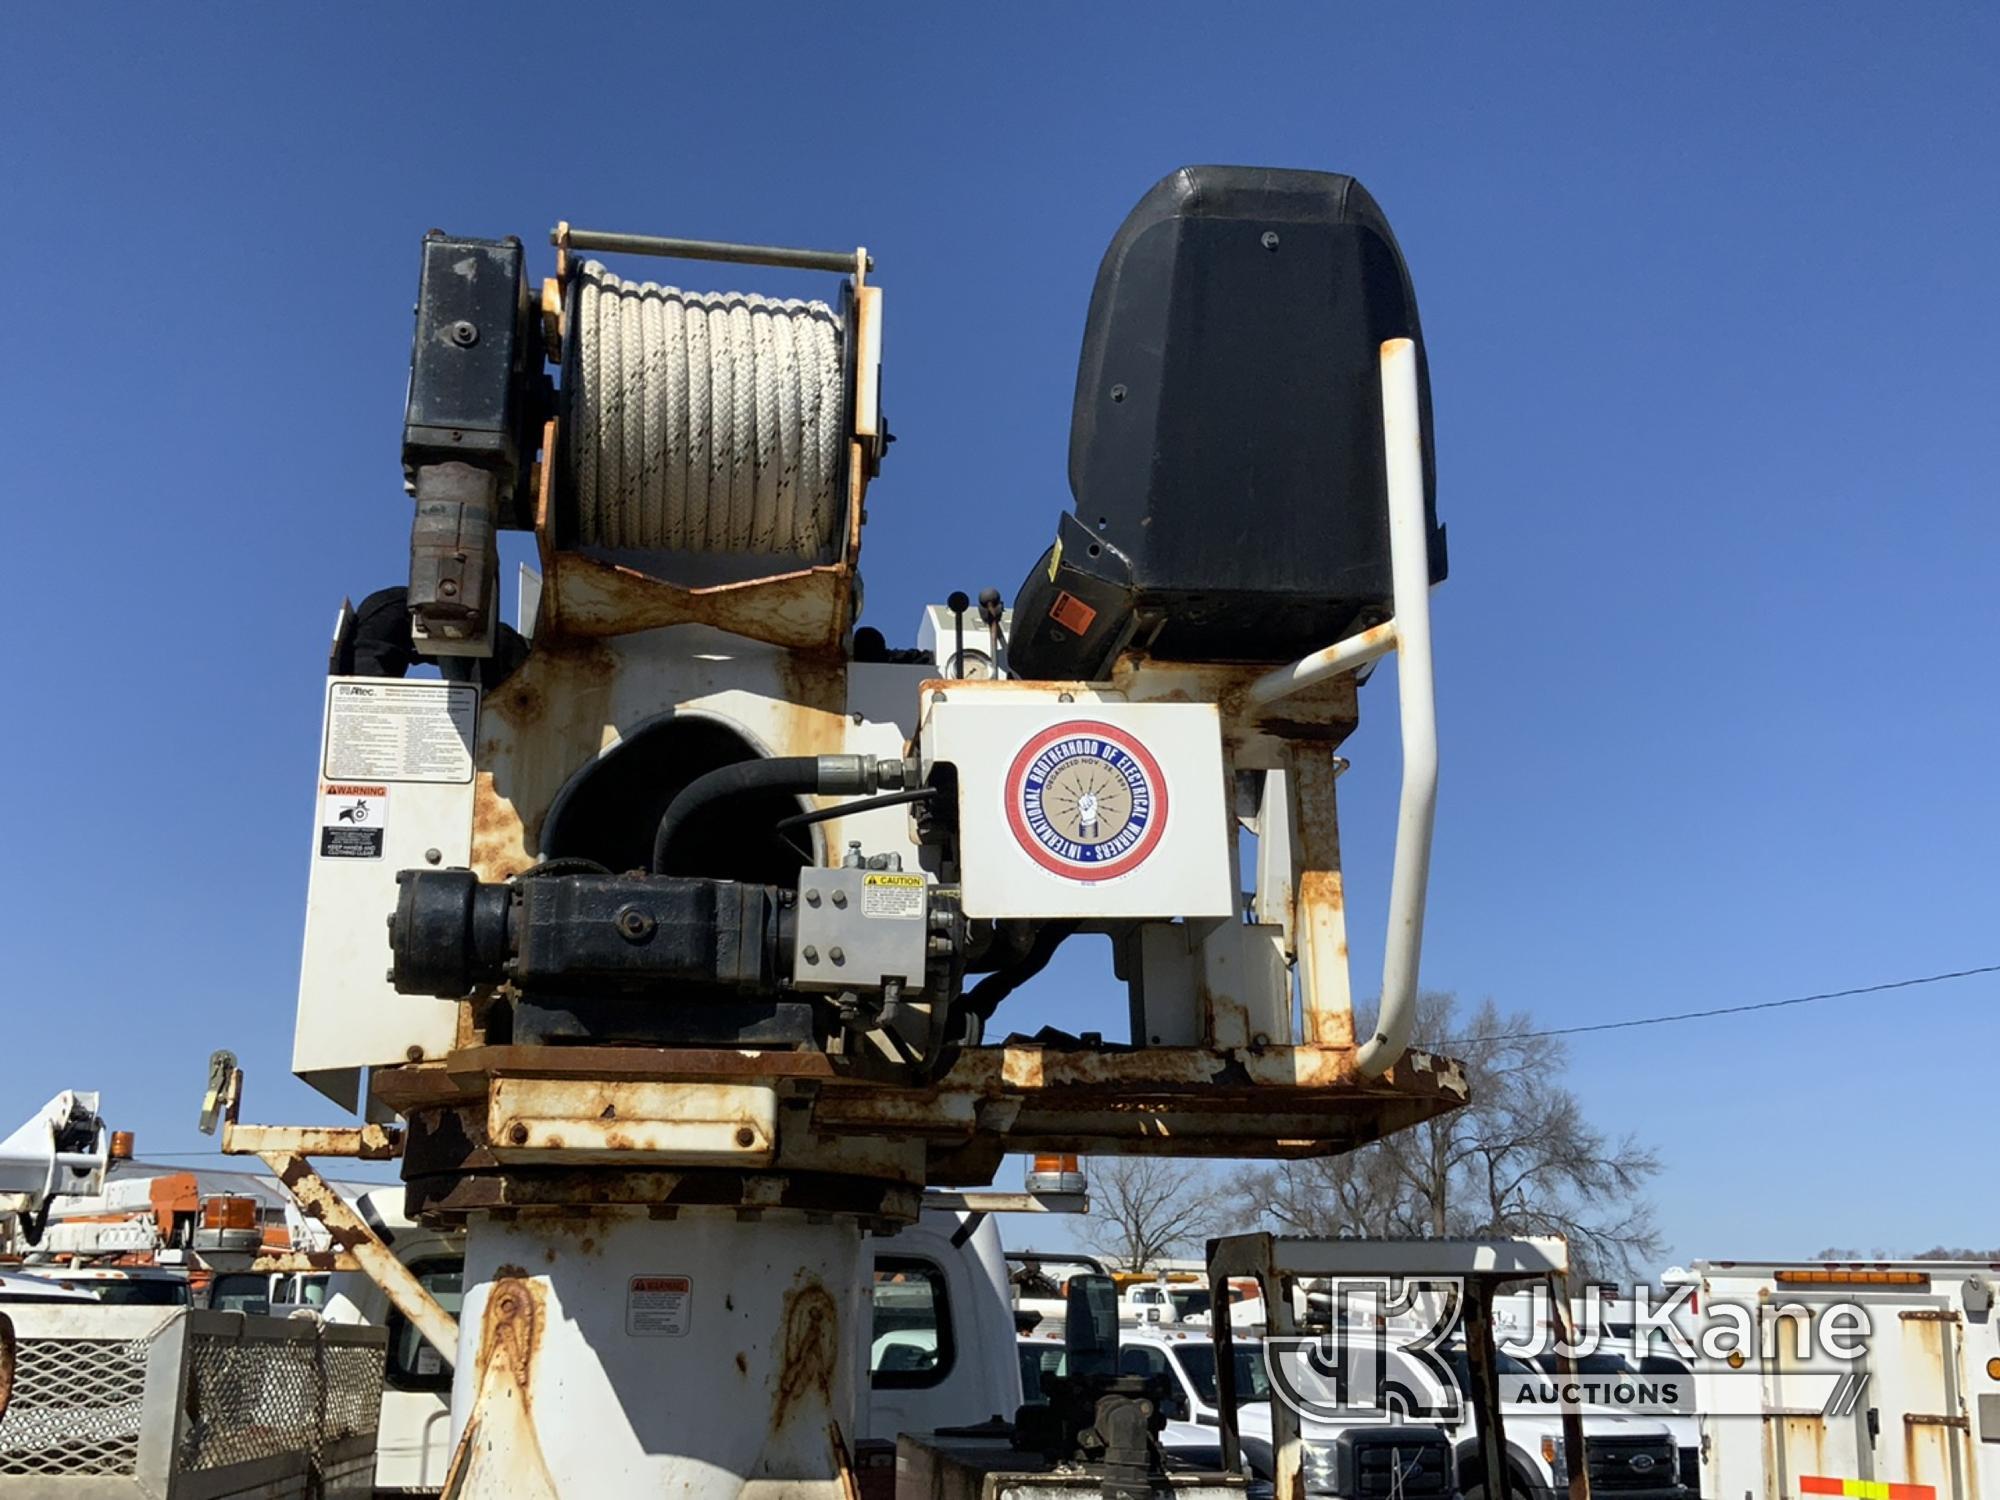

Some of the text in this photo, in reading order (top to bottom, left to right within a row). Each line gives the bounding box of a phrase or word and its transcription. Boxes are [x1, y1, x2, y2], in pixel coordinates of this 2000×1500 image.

[1030, 740, 1098, 784] BROTHERHOOD
[1102, 746, 1117, 761] OF
[336, 787, 386, 796] WARNING
[1117, 757, 1149, 819] ELECTRICAL
[1026, 788, 1082, 860] INTERNATIONAL
[1096, 822, 1142, 860] WORKERS
[880, 876, 920, 885] CAUTION
